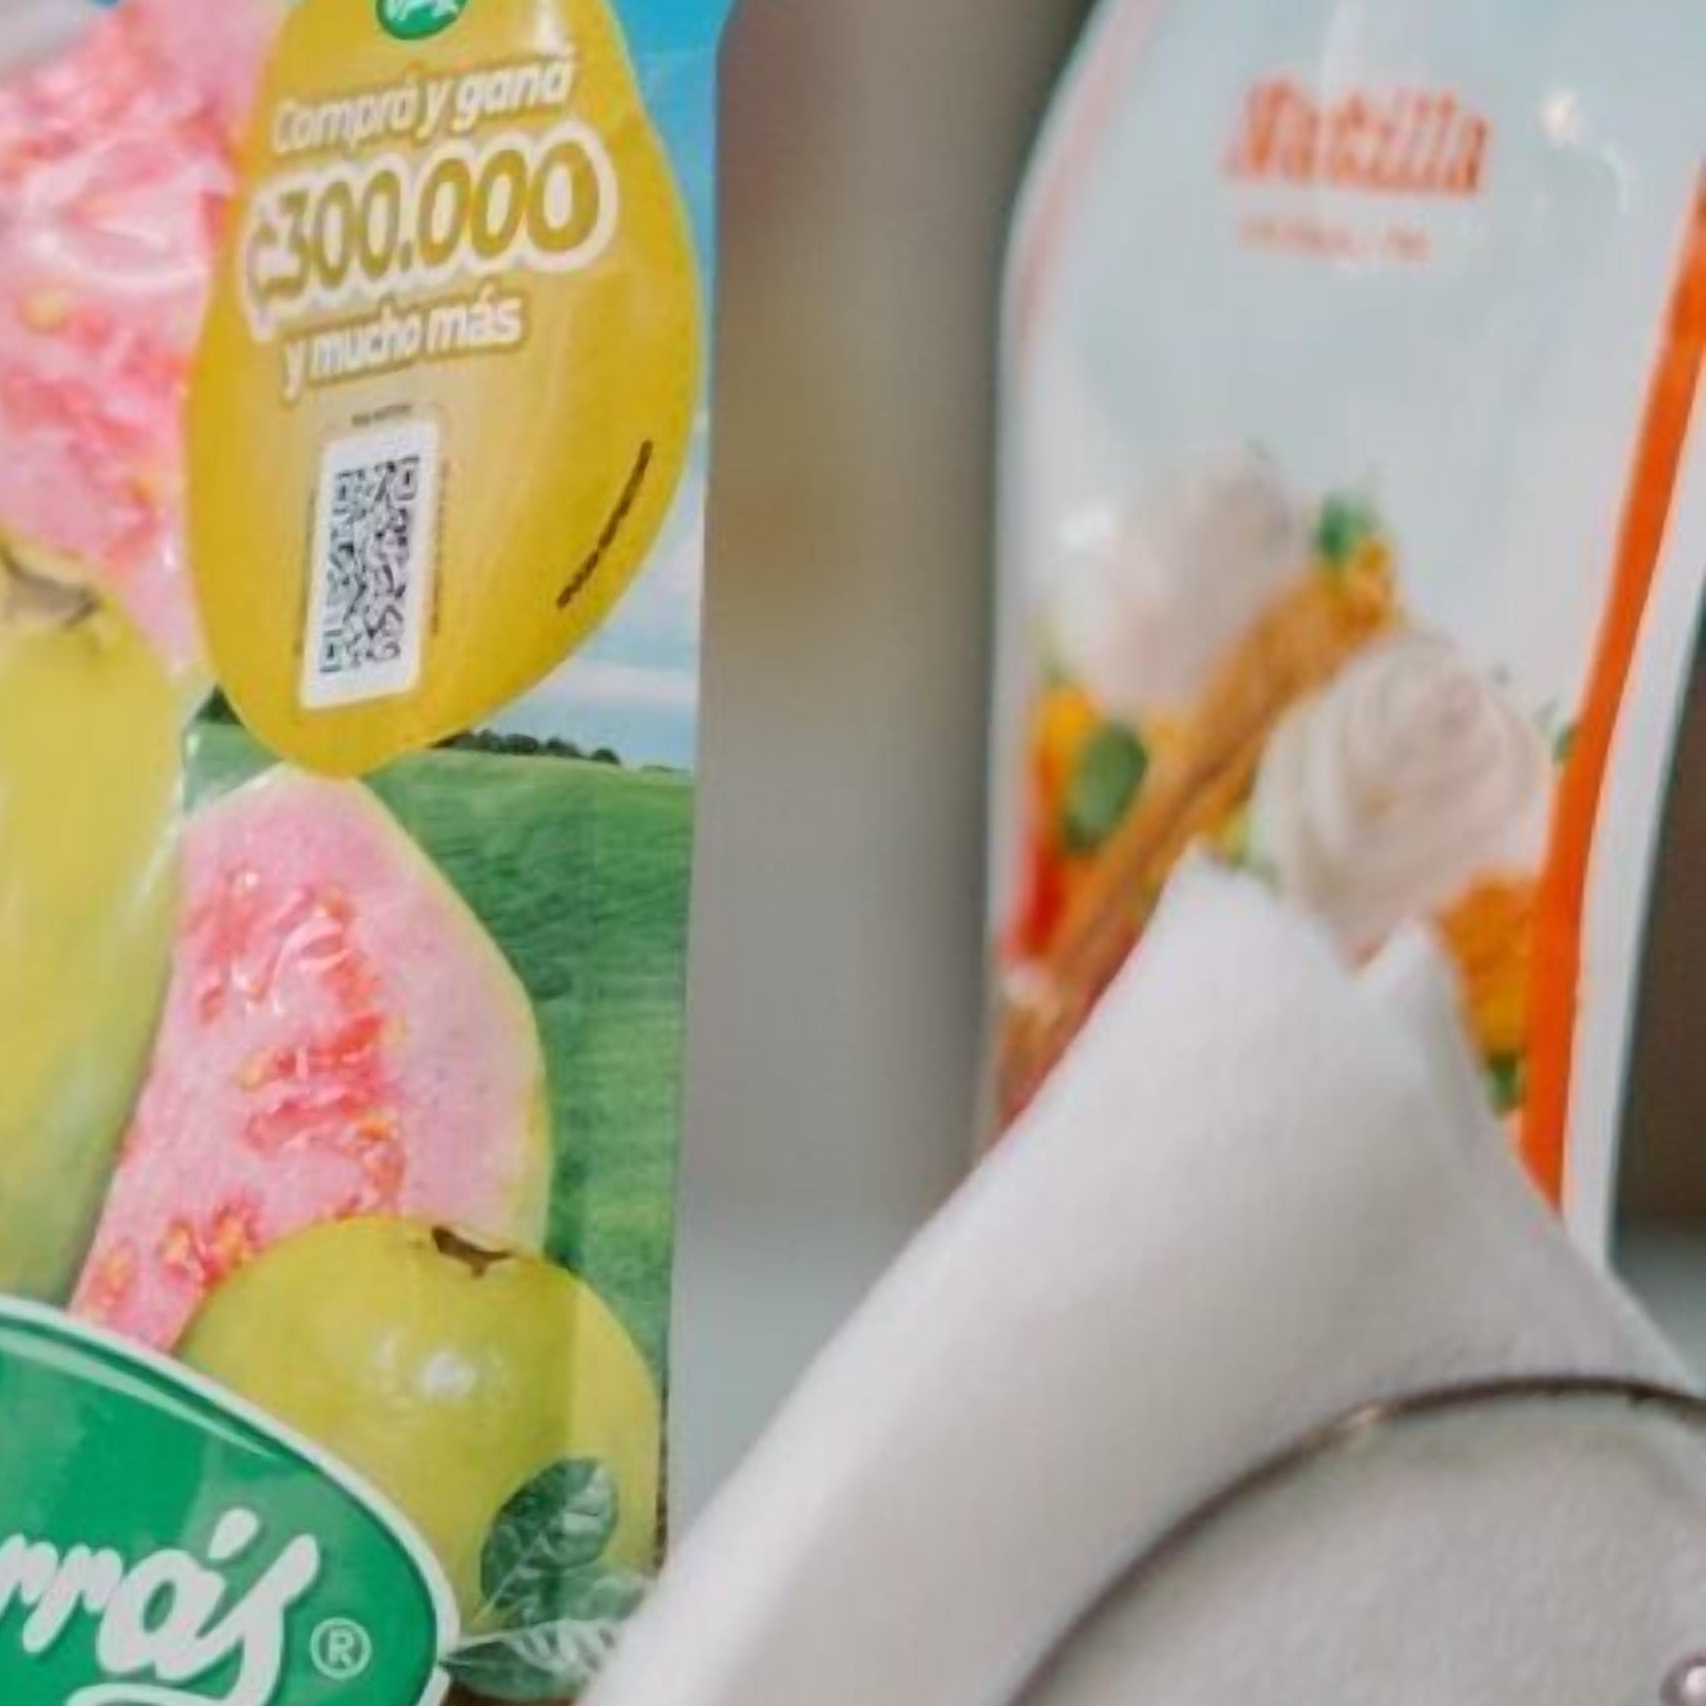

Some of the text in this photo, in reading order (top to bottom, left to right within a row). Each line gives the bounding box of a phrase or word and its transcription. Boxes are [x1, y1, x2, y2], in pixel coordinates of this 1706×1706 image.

[416, 77, 454, 141] y
[282, 279, 526, 403] y mucho más
